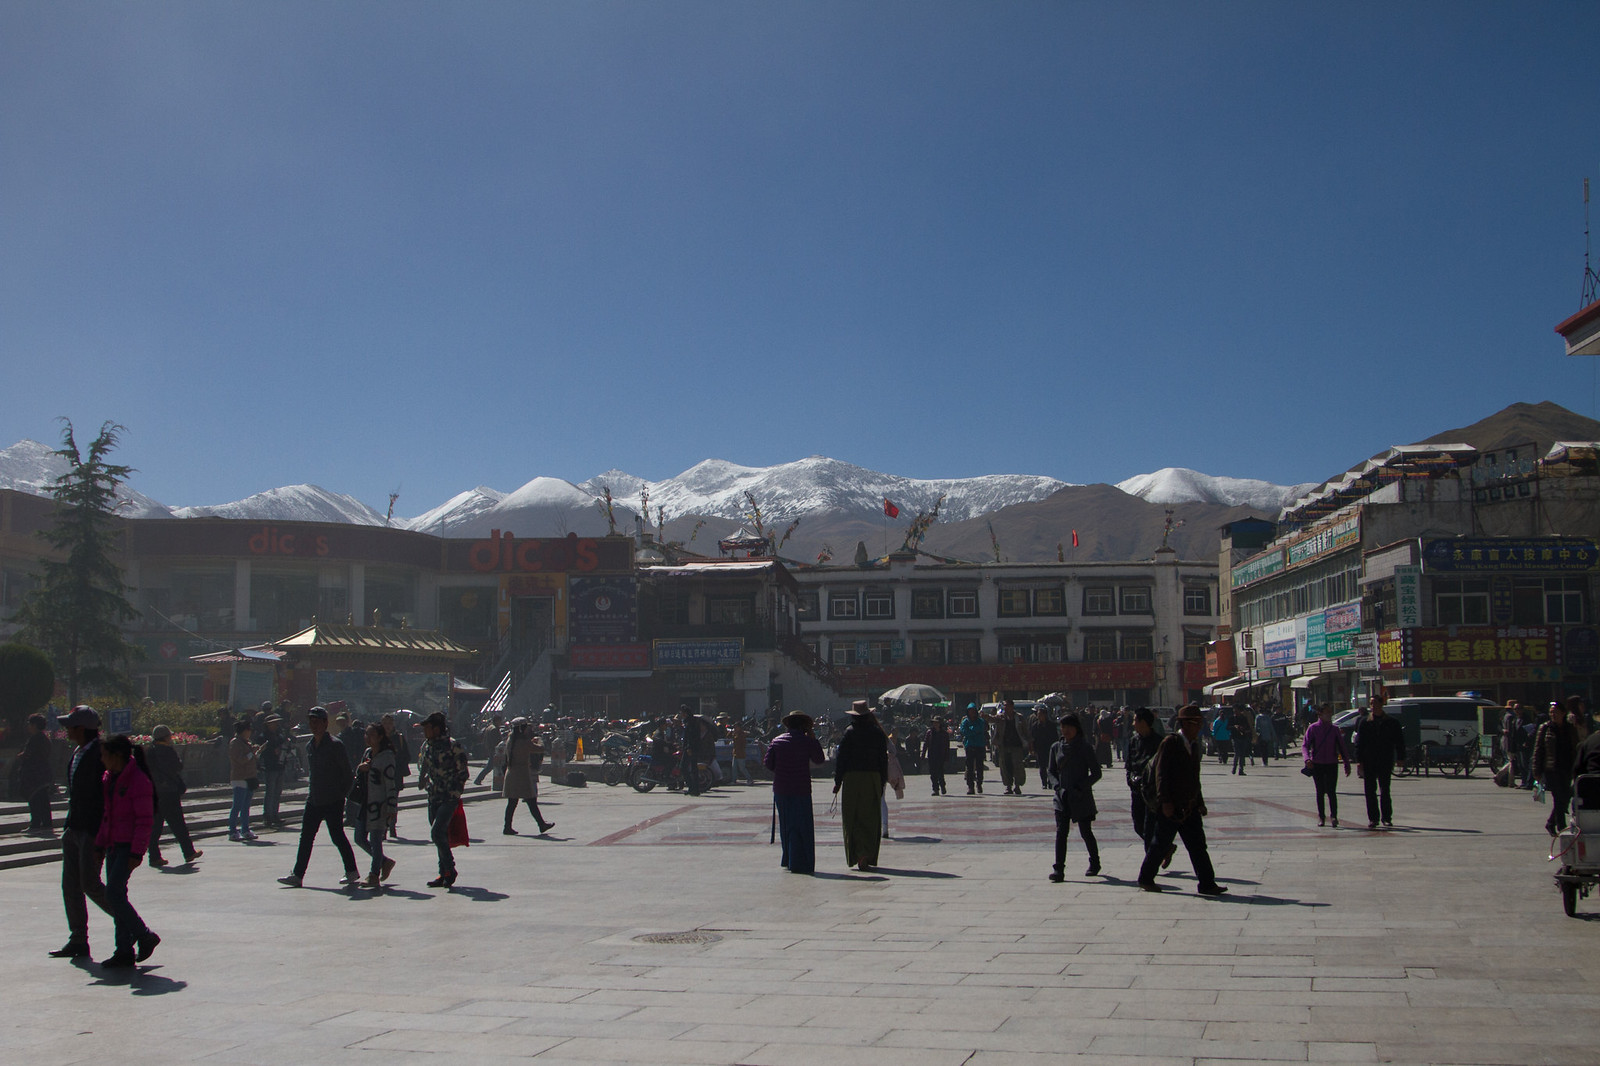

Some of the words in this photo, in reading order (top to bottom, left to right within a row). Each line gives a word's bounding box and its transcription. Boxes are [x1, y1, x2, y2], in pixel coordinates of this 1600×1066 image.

[1400, 575, 1417, 625] 藏宝绿松石
[1421, 639, 1548, 662] 藏宝绿松石
